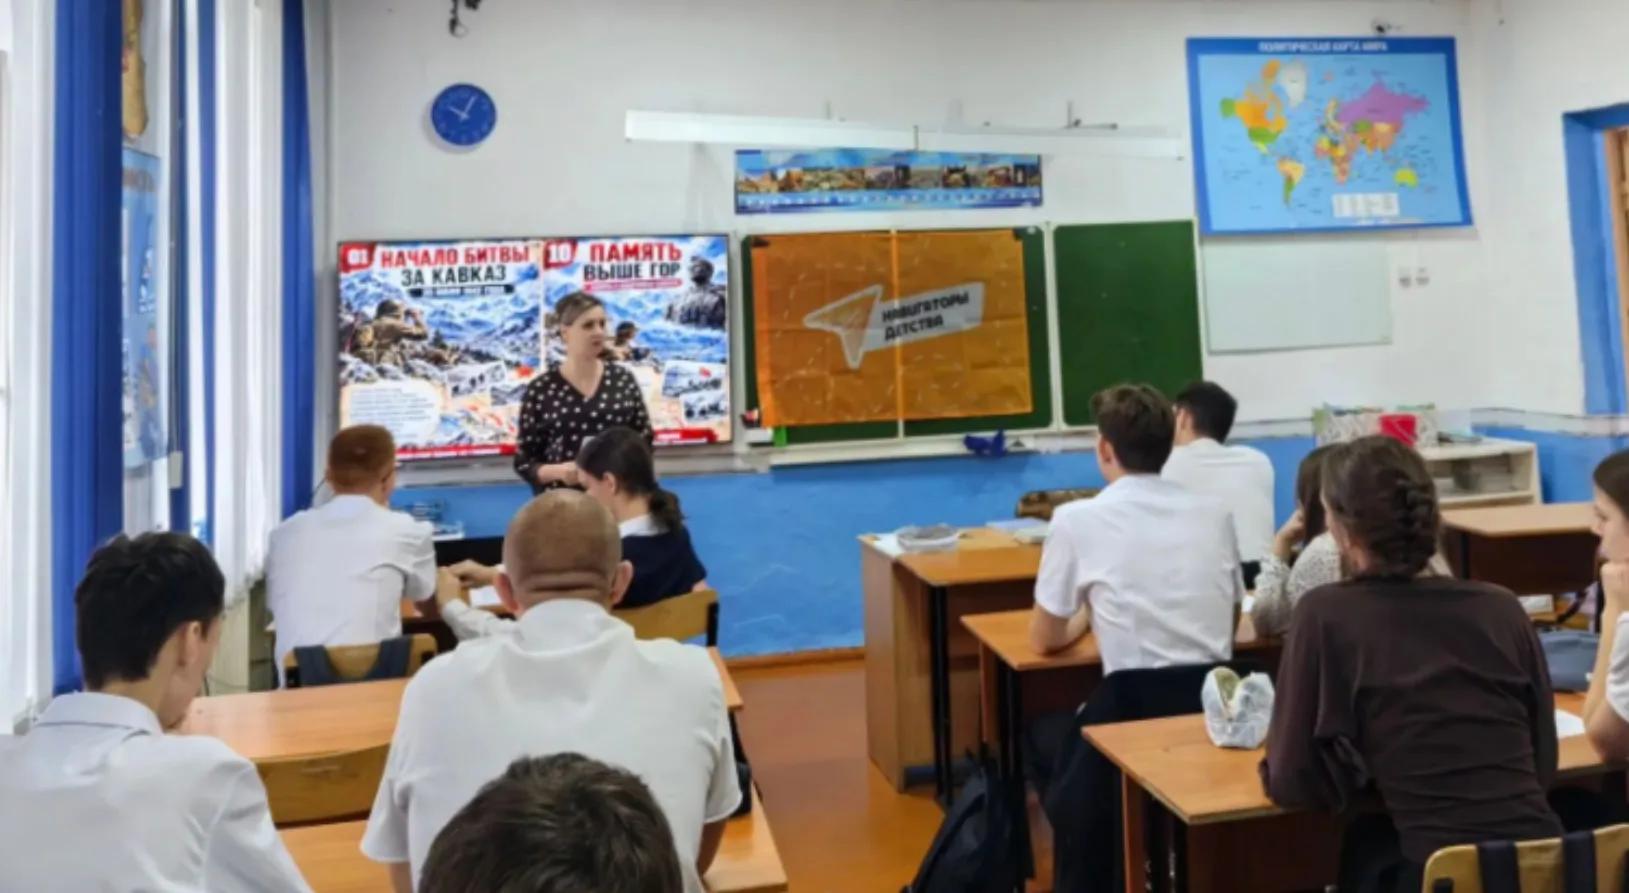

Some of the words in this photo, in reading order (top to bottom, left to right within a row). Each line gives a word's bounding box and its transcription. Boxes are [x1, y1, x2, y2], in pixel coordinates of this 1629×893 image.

[381, 249, 458, 268] НАЧАЛО
[464, 245, 530, 264] БИТВЫ
[548, 243, 573, 264] 10
[589, 242, 683, 262] ПАМЯТЬ
[401, 269, 425, 287] ЗА
[432, 265, 507, 285] КАВКАЗ
[583, 263, 642, 281] ВЫШЕ
[650, 262, 681, 277] ГОР
[882, 291, 970, 322] НАВИГАТОРЫ
[884, 314, 944, 341] ДЕТСТВА
